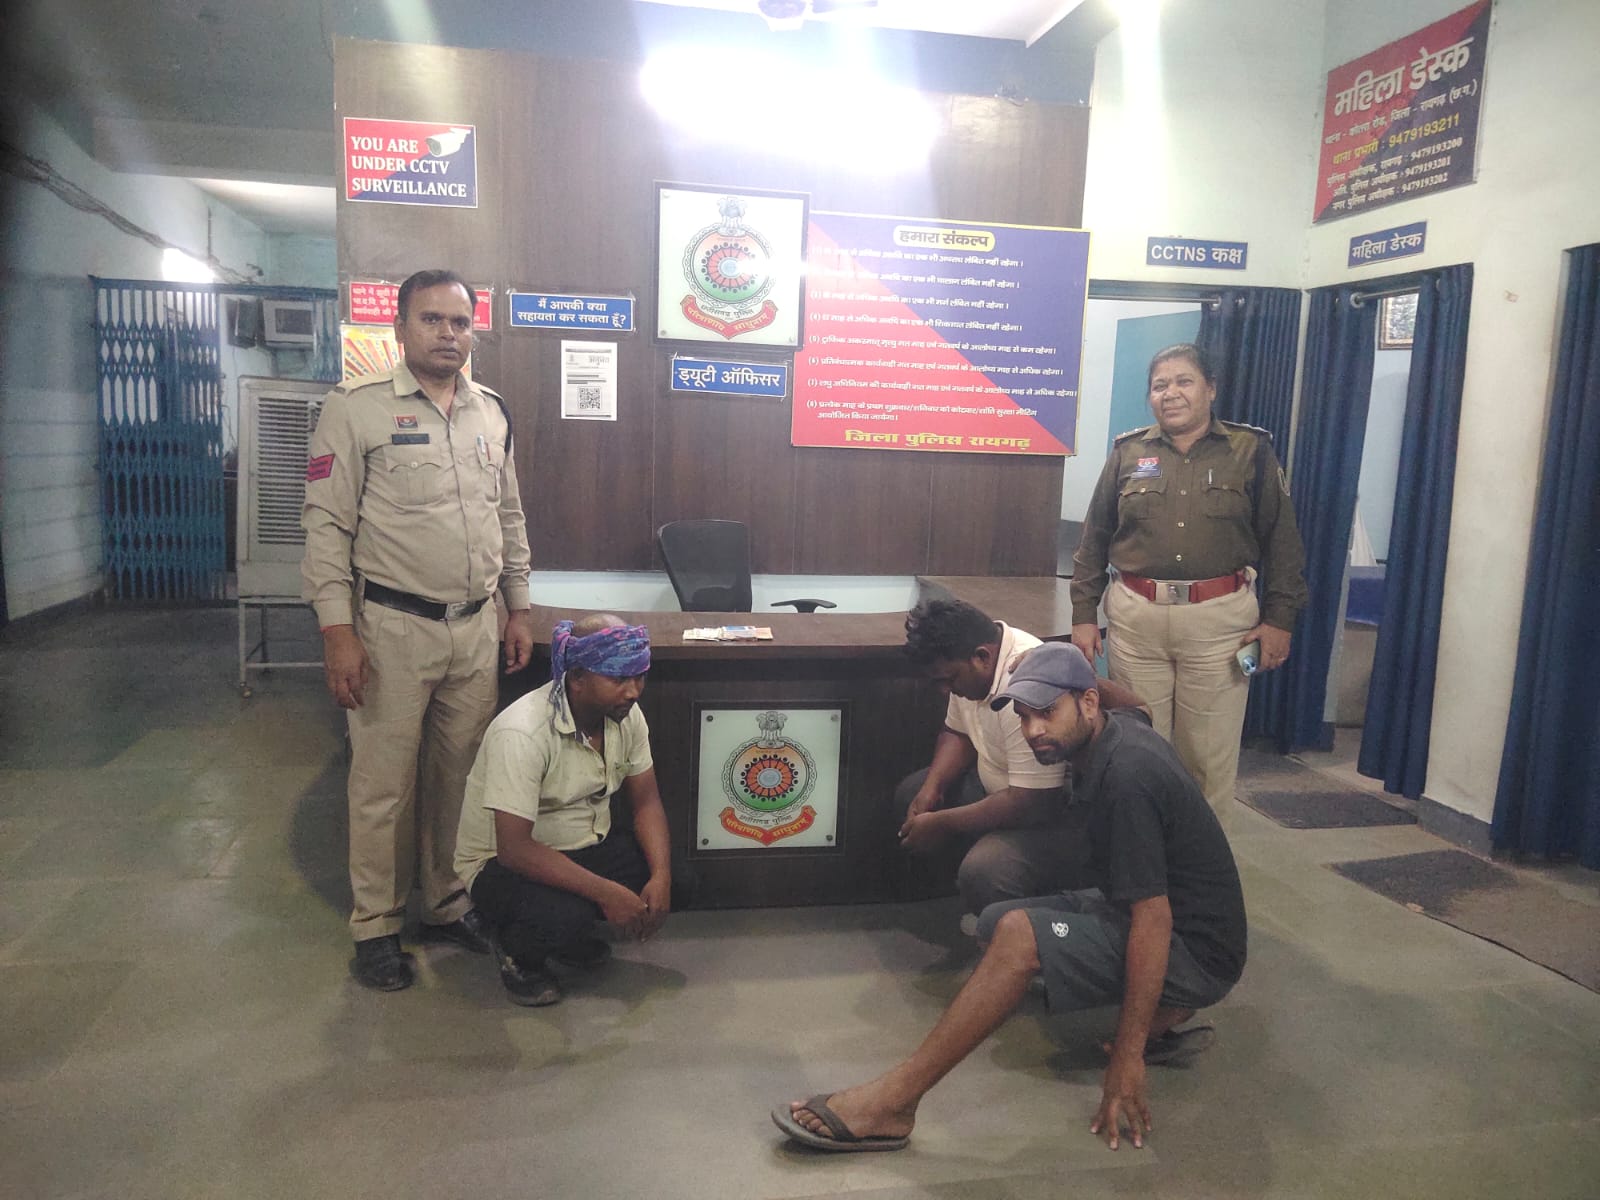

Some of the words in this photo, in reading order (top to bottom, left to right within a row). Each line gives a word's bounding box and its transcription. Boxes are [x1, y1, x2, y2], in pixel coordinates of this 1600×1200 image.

[1334, 66, 1406, 117] महिला
[1409, 36, 1475, 91] डेस्क
[1390, 106, 1411, 122] जिला
[351, 136, 383, 152] YOU
[387, 138, 419, 153] ARE
[1333, 150, 1351, 165] थाना
[1354, 138, 1379, 158] प्रभारी
[1388, 112, 1460, 149] 9479193211
[352, 155, 407, 172] UNDER
[409, 159, 450, 174] CCTV
[352, 178, 467, 197] SURVEILLANCE
[899, 230, 941, 243] हमारा
[942, 230, 989, 247] संकल्प
[1352, 239, 1387, 259] महिला
[1390, 233, 1423, 251] डेस्क
[1151, 245, 1207, 262] CCTNS
[1211, 247, 1244, 264] कक्ष
[537, 297, 547, 309] मैं
[550, 299, 584, 310] आपकी
[587, 303, 607, 312] क्या
[517, 310, 556, 322] सहायता
[559, 312, 576, 323] कर
[578, 314, 609, 324] सकता
[677, 365, 717, 388] ड्यूटी
[720, 367, 781, 387] ऑफिसर
[845, 429, 901, 443] जिला
[904, 432, 964, 447] पुलिस
[968, 436, 1032, 451] रायगढ़
